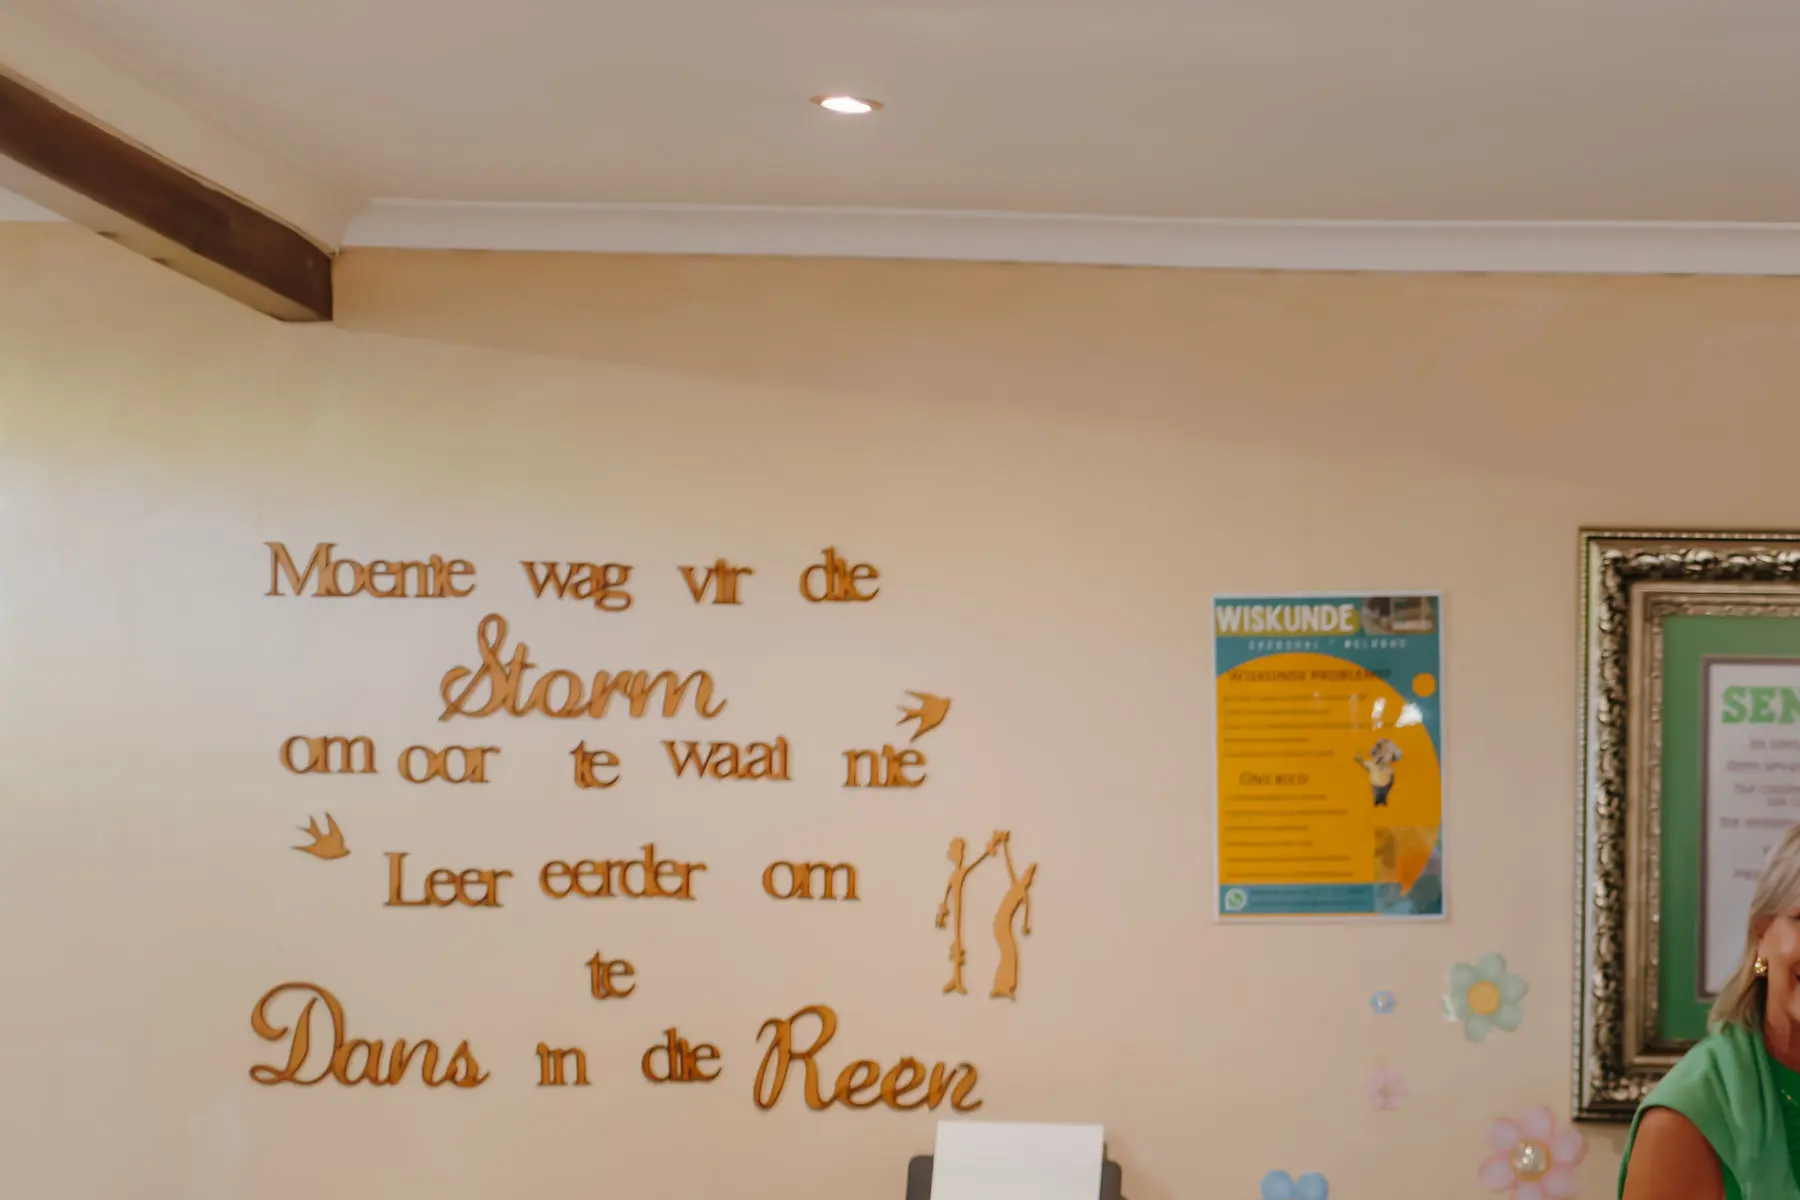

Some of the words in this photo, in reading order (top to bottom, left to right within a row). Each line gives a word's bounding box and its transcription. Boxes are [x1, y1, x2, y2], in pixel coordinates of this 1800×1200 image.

[263, 540, 477, 599] Moenie
[519, 560, 633, 613] wag
[678, 557, 754, 606] vir
[799, 545, 880, 603] die
[1214, 604, 1355, 633] WISKUNDE
[437, 612, 728, 722] Storm
[279, 734, 380, 776] om
[396, 744, 501, 785] oor
[569, 739, 622, 790] te
[661, 734, 793, 782] waai
[840, 743, 928, 789] nie
[382, 851, 514, 908] Leer
[538, 842, 707, 901] eerder
[761, 858, 862, 902] om
[585, 948, 637, 1001] te
[249, 981, 491, 1089] Dans
[535, 1040, 593, 1087] in
[640, 1026, 723, 1083] die
